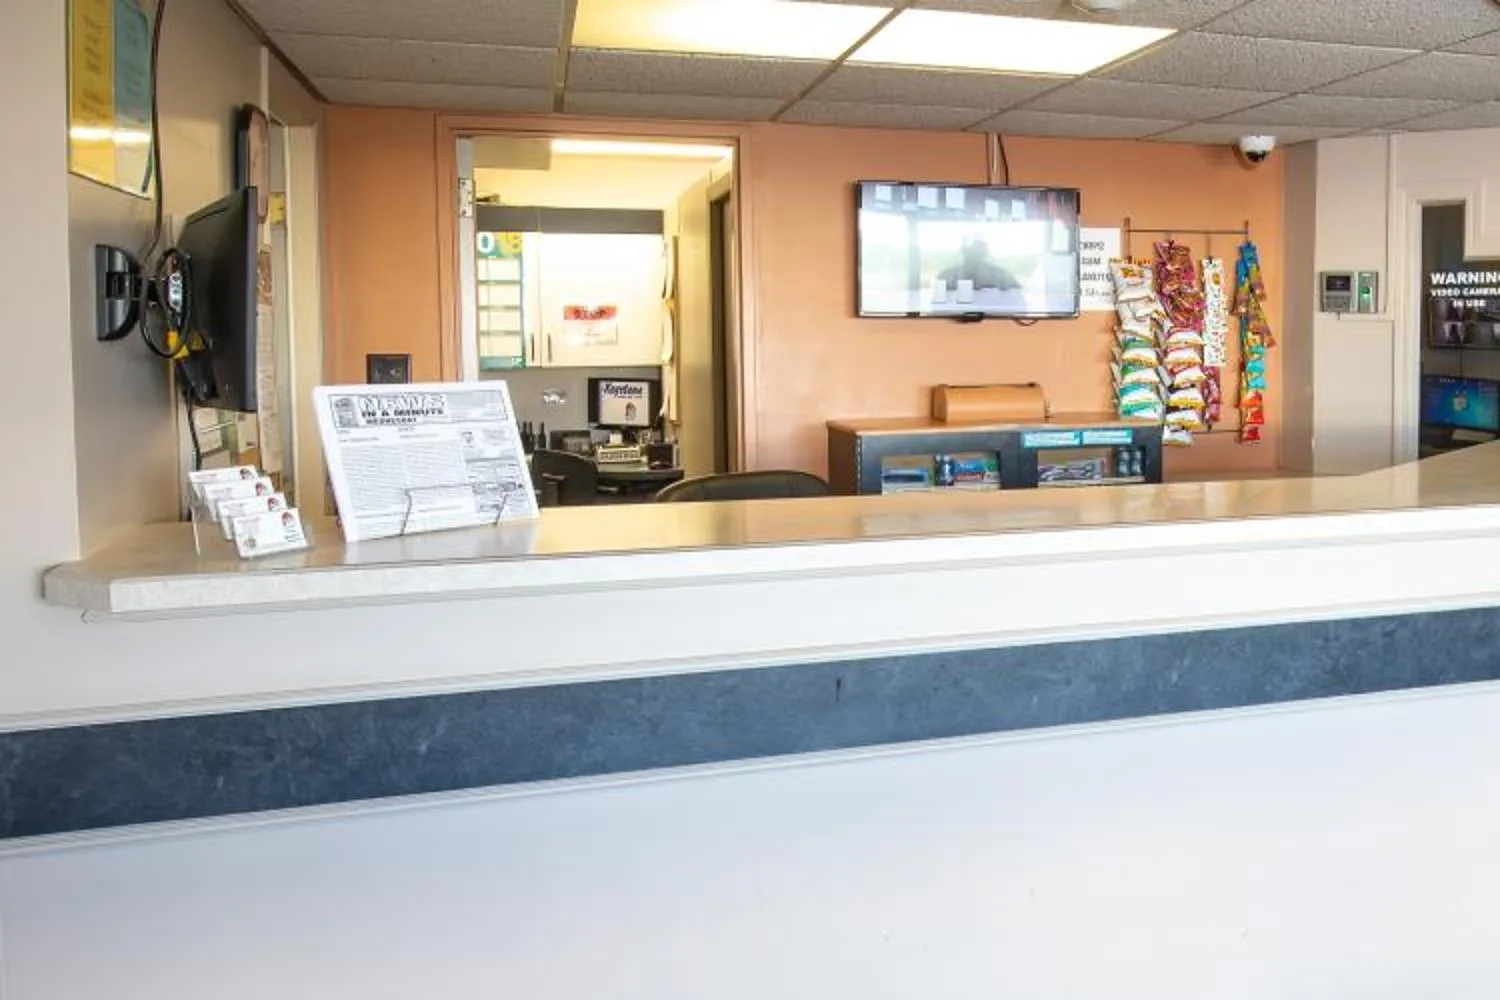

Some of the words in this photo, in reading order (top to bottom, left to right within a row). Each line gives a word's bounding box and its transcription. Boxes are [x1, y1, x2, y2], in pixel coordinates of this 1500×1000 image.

[1430, 288, 1461, 296] VIDEO
[1453, 299, 1464, 308] IN
[1465, 299, 1486, 307] USE
[361, 394, 446, 410] NEWS
[381, 409, 391, 417] A
[394, 407, 444, 416] MINUTE
